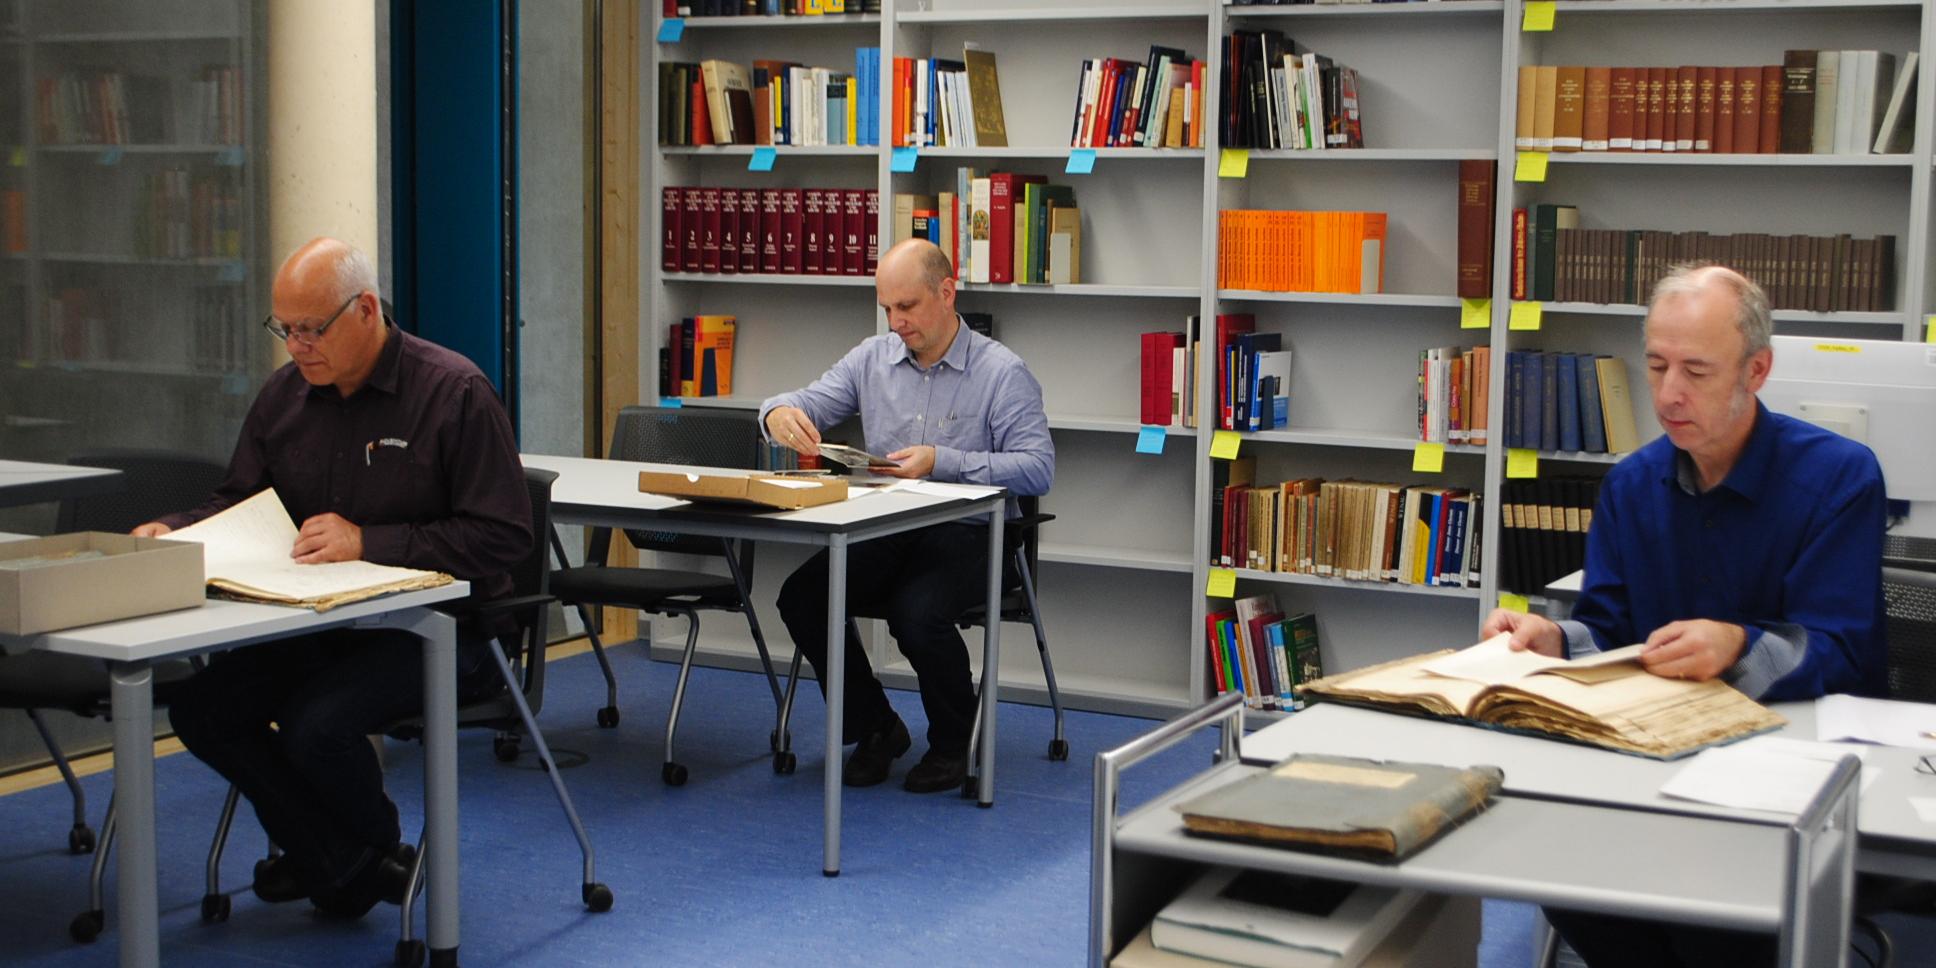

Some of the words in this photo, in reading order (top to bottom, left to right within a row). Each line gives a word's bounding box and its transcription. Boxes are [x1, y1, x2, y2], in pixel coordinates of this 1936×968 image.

[668, 230, 673, 241] 1
[690, 230, 695, 241] 2
[707, 231, 713, 241] 3
[726, 232, 732, 242] 4
[746, 232, 751, 242] 5
[767, 232, 773, 242] 6
[786, 232, 792, 243] 7
[810, 232, 816, 243] 8
[828, 233, 834, 244] 9
[848, 234, 857, 245] 10
[869, 234, 877, 245] 11
